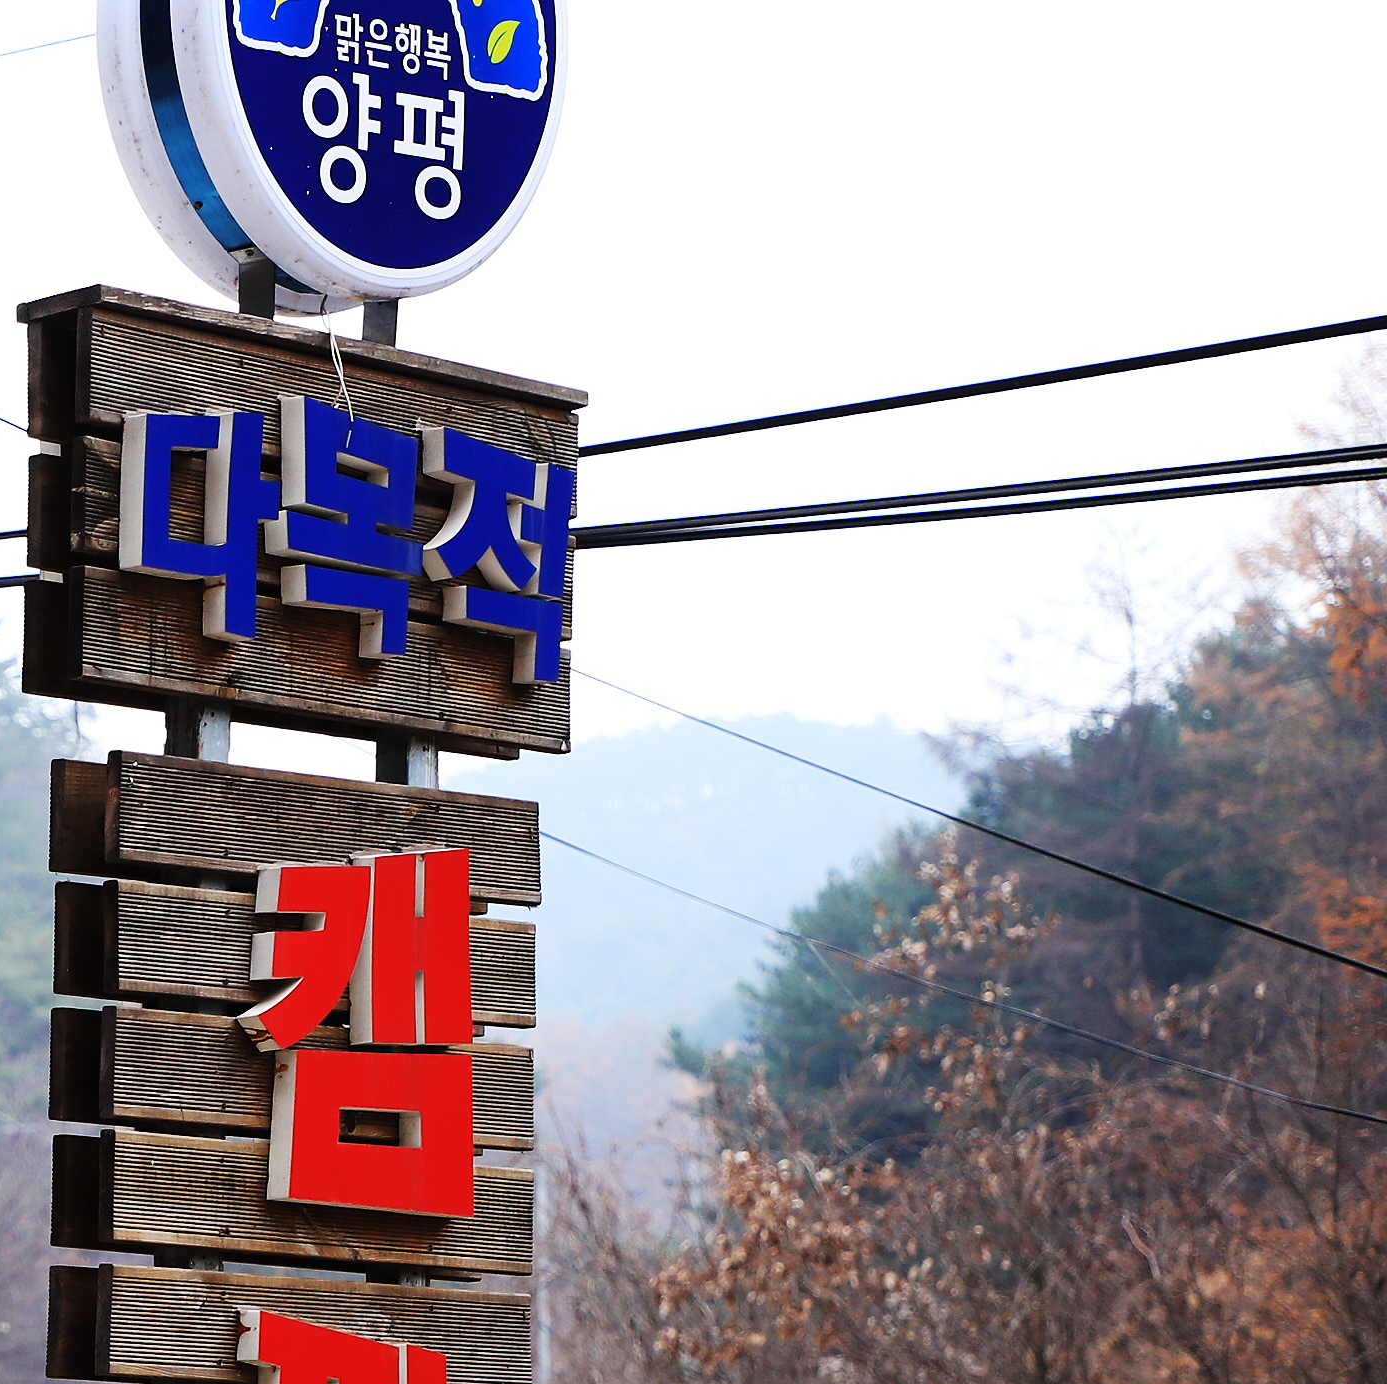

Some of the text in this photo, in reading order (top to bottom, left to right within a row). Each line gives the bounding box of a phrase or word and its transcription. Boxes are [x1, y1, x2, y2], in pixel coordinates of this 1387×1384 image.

[334, 13, 453, 81] 맑은행복
[302, 73, 466, 220] 양평
[119, 396, 575, 684] 다목적
